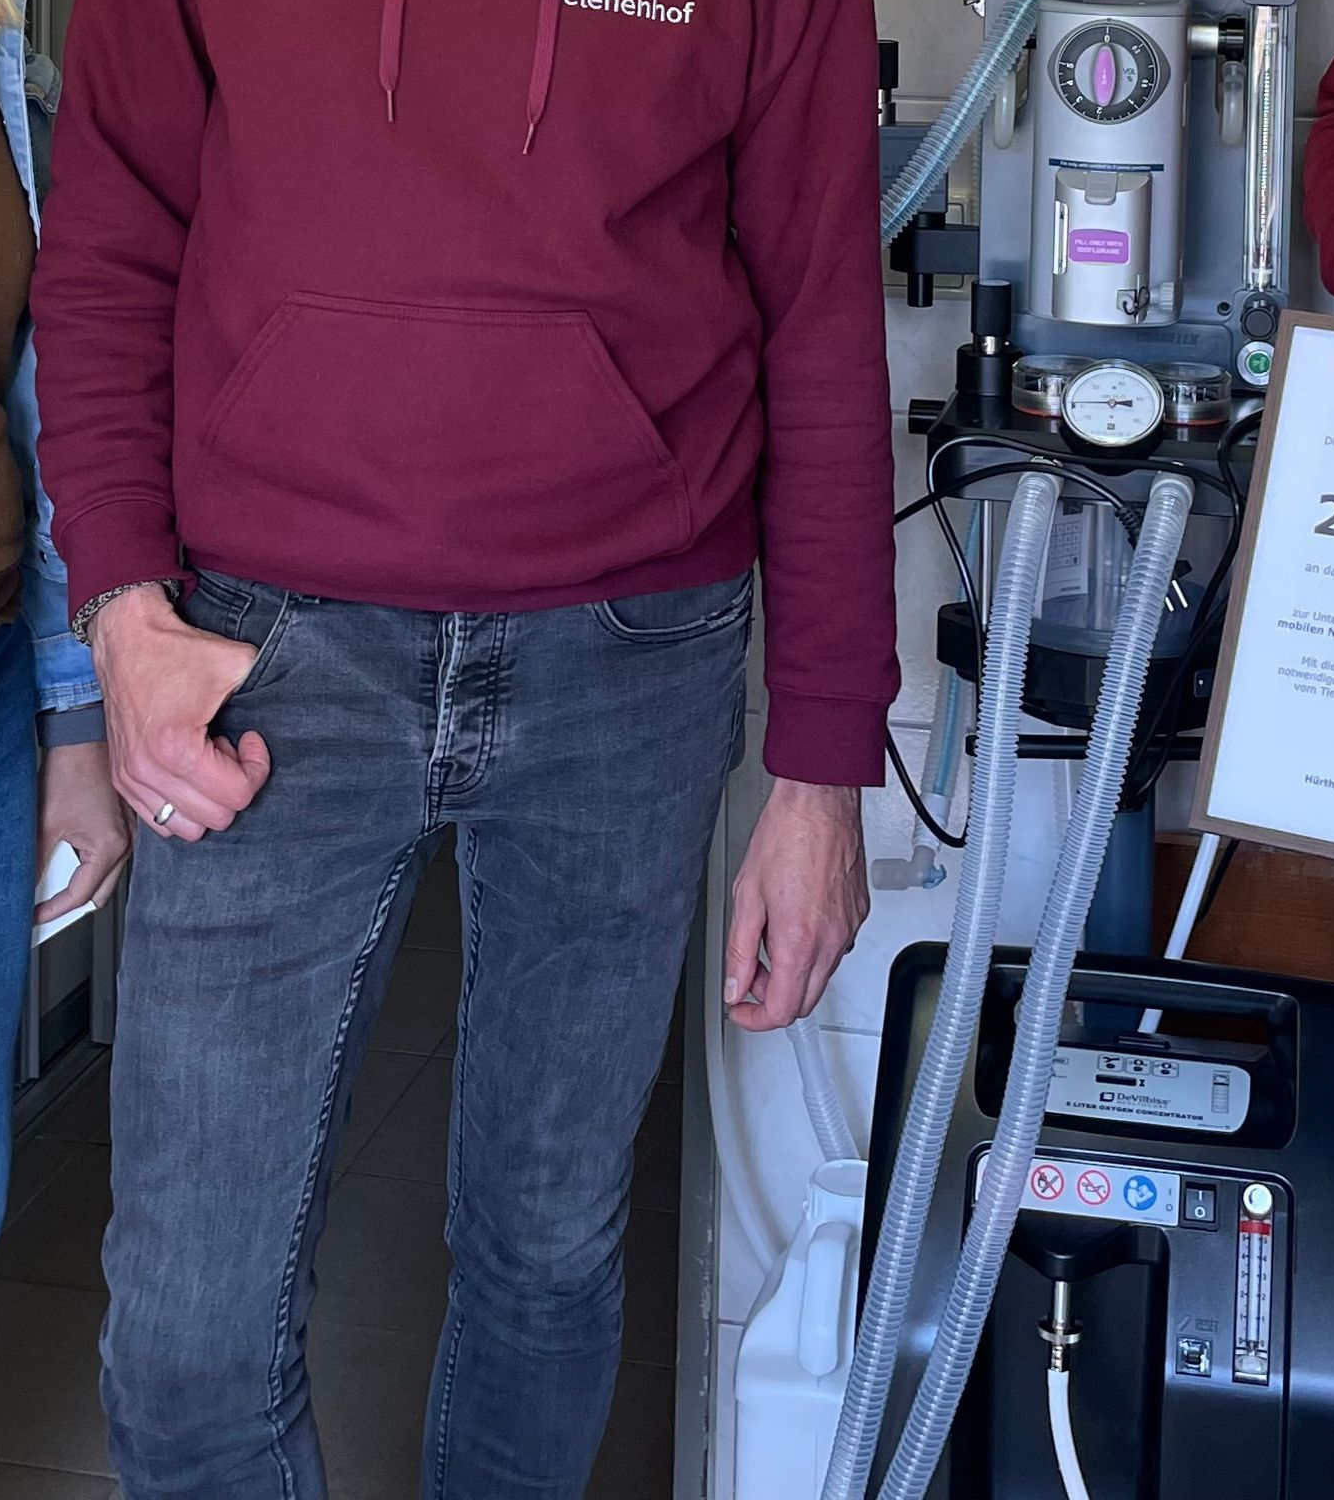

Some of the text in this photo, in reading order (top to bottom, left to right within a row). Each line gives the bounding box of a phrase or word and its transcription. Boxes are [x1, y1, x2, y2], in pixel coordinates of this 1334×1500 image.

[1304, 562, 1320, 574] an
[1292, 608, 1311, 621] zur
[1277, 618, 1325, 636] mobilen
[1294, 682, 1317, 695] vom
[1074, 1102, 1097, 1110] LITER
[1099, 1104, 1134, 1114] OXYGEN
[1136, 1108, 1204, 1121] CONCENTRATOR
